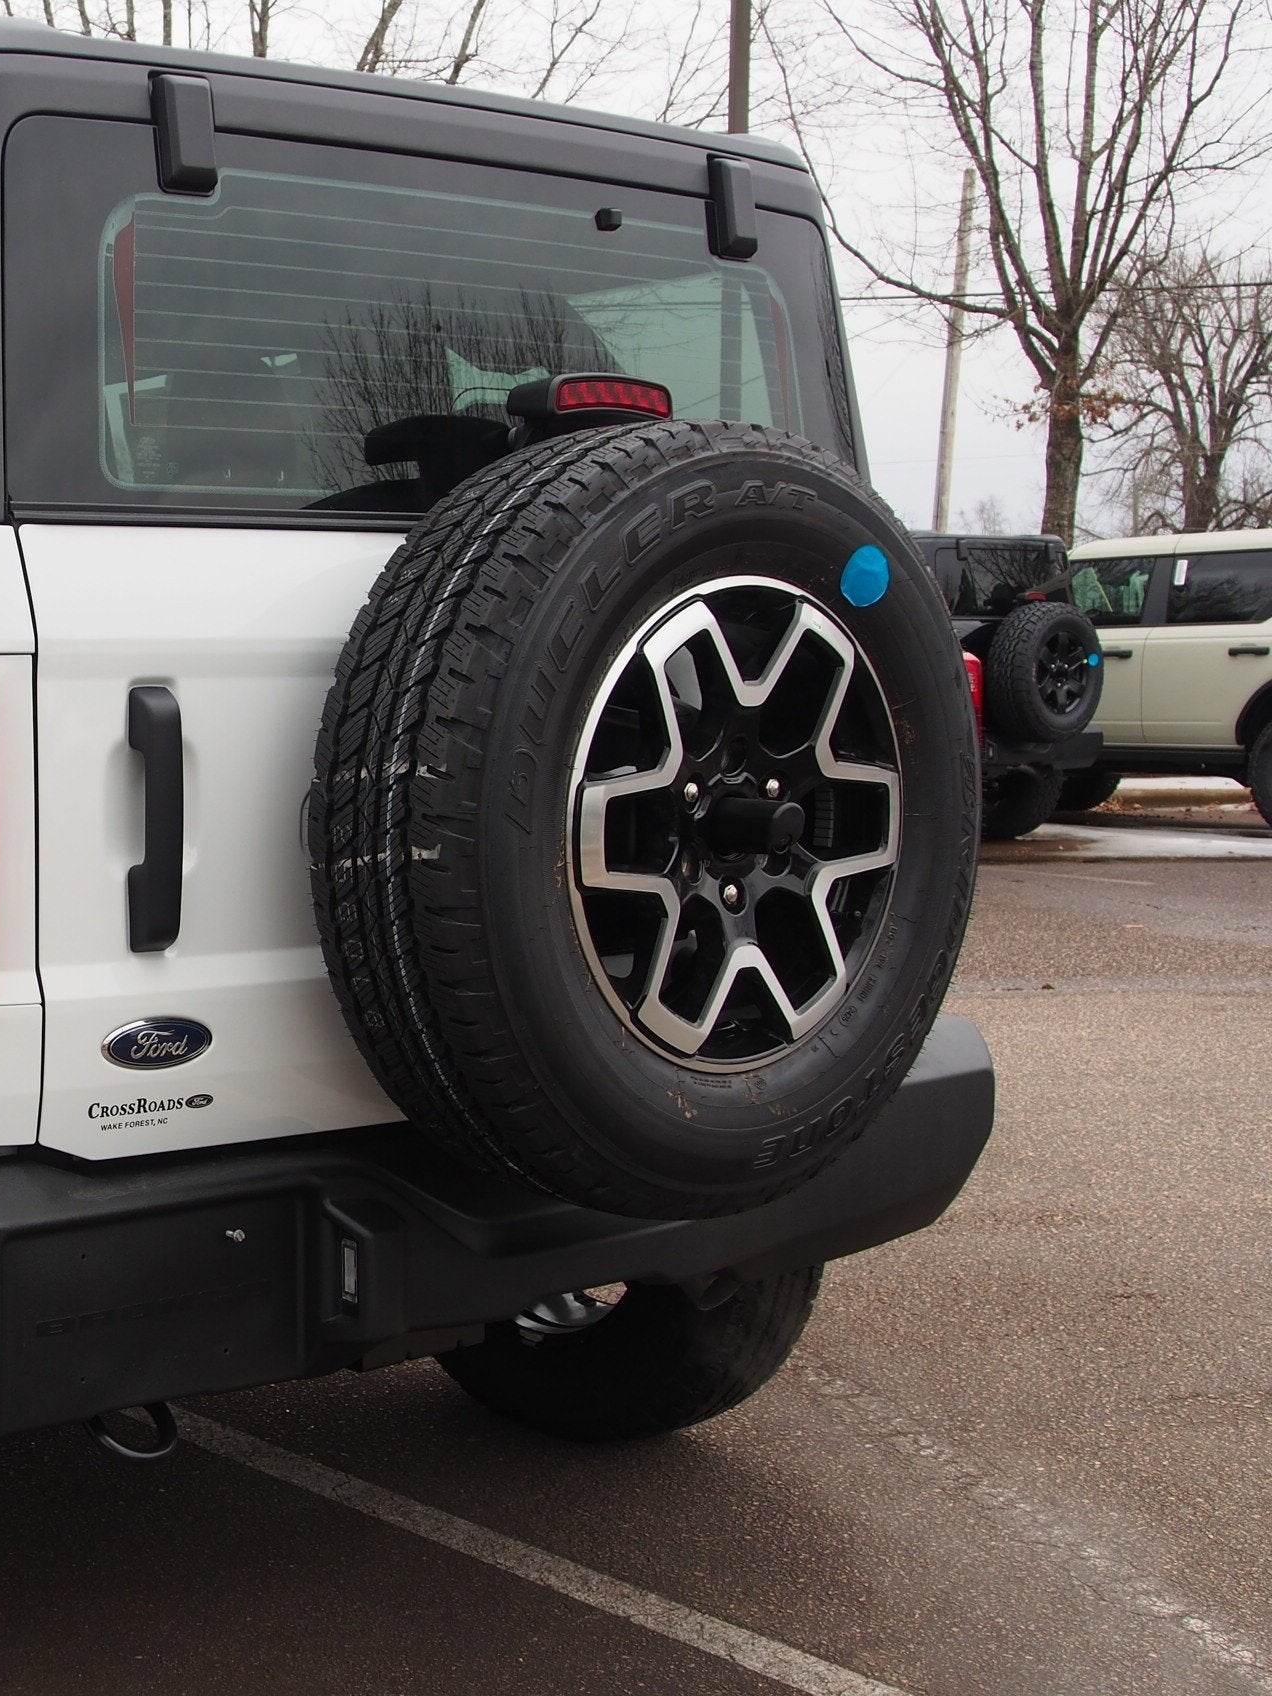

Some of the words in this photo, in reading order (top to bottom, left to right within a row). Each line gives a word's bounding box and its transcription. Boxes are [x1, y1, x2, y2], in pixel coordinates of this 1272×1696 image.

[734, 479, 818, 512] A/T
[130, 1029, 188, 1060] Ford
[100, 1122, 123, 1131] WAKE
[124, 1119, 156, 1129] FOREST,
[157, 1117, 168, 1125] NC
